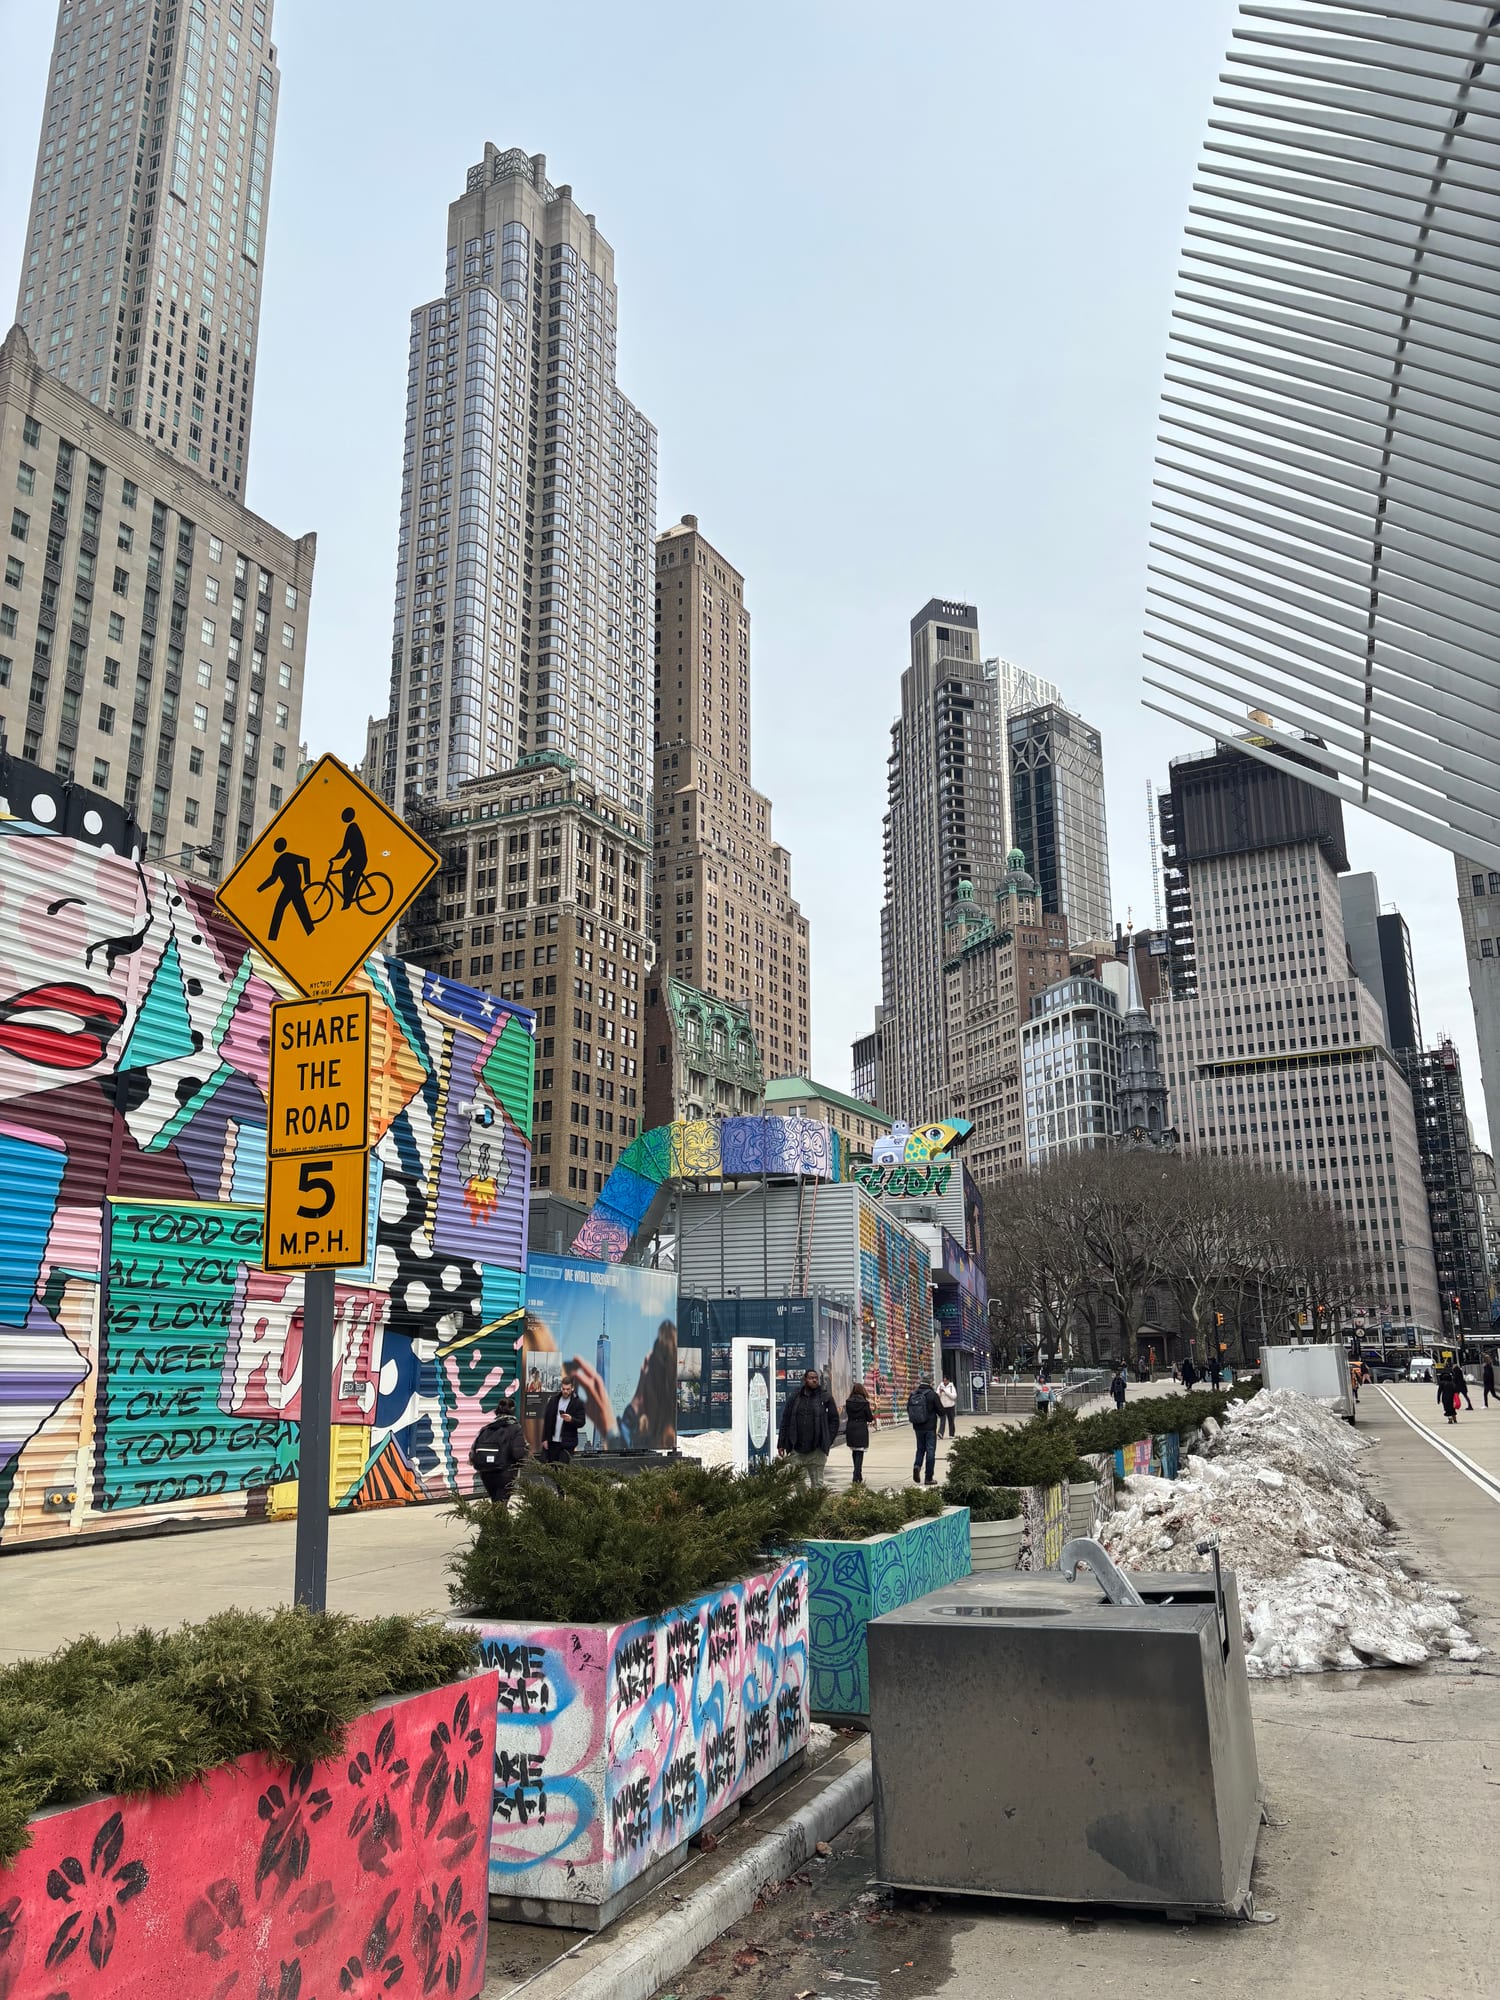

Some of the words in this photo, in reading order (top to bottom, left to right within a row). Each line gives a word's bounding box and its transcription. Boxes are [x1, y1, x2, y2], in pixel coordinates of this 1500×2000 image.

[281, 1013, 359, 1050] SHARE
[297, 1059, 341, 1091] THE
[286, 1102, 350, 1136] ROAD
[296, 1160, 336, 1219] 5
[127, 1214, 224, 1245] TODD
[280, 1229, 349, 1255] M.P.H.
[103, 1386, 204, 1424] LOVE
[116, 1426, 217, 1466] TODD
